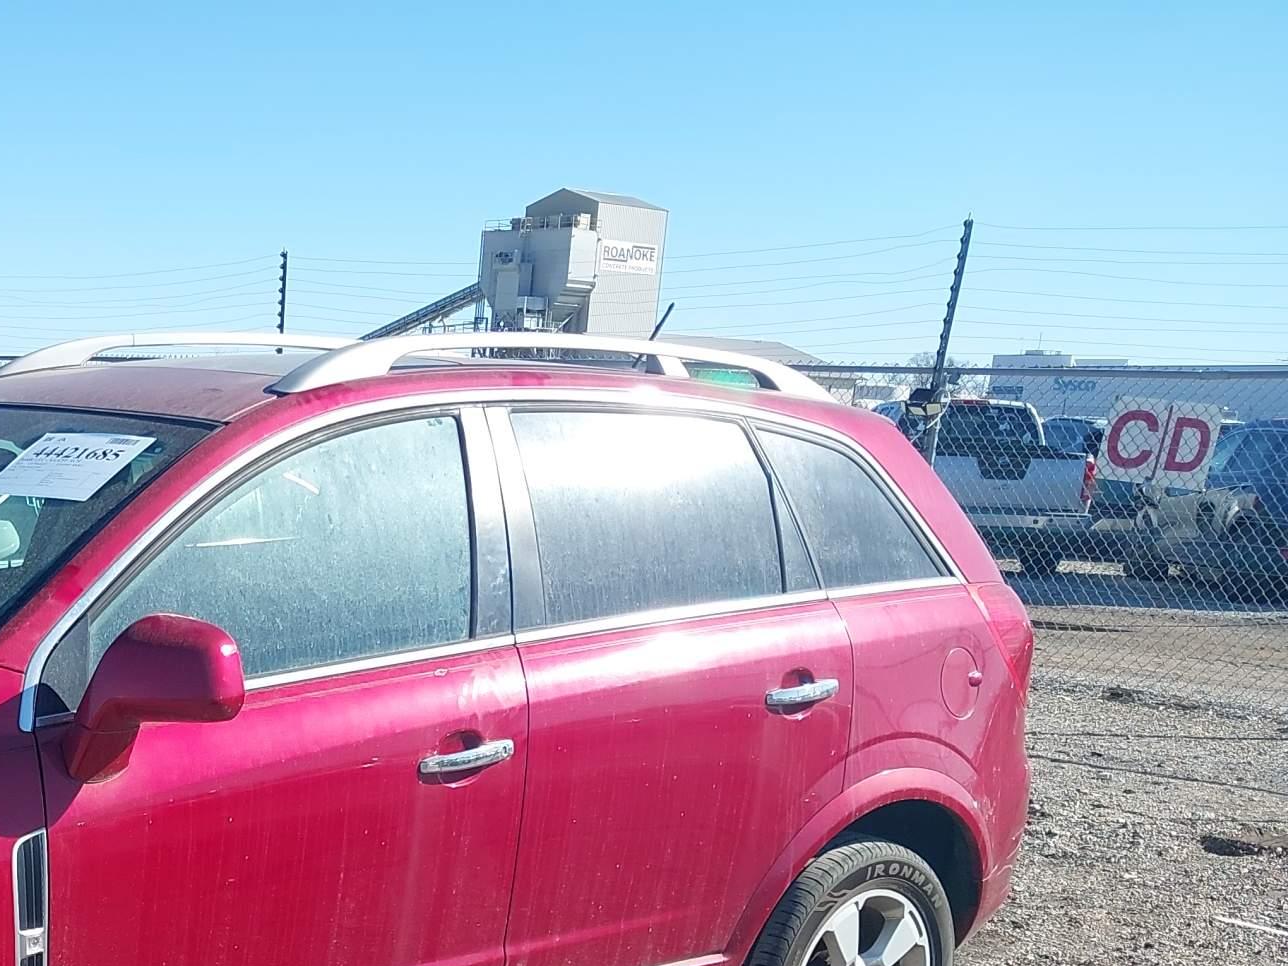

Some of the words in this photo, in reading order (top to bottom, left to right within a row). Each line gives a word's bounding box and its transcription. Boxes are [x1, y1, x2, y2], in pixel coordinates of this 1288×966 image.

[603, 245, 655, 262] ROANOKE
[1053, 376, 1096, 394] Sysco
[32, 446, 126, 461] 44421685
[866, 863, 942, 908] IRONMAN
